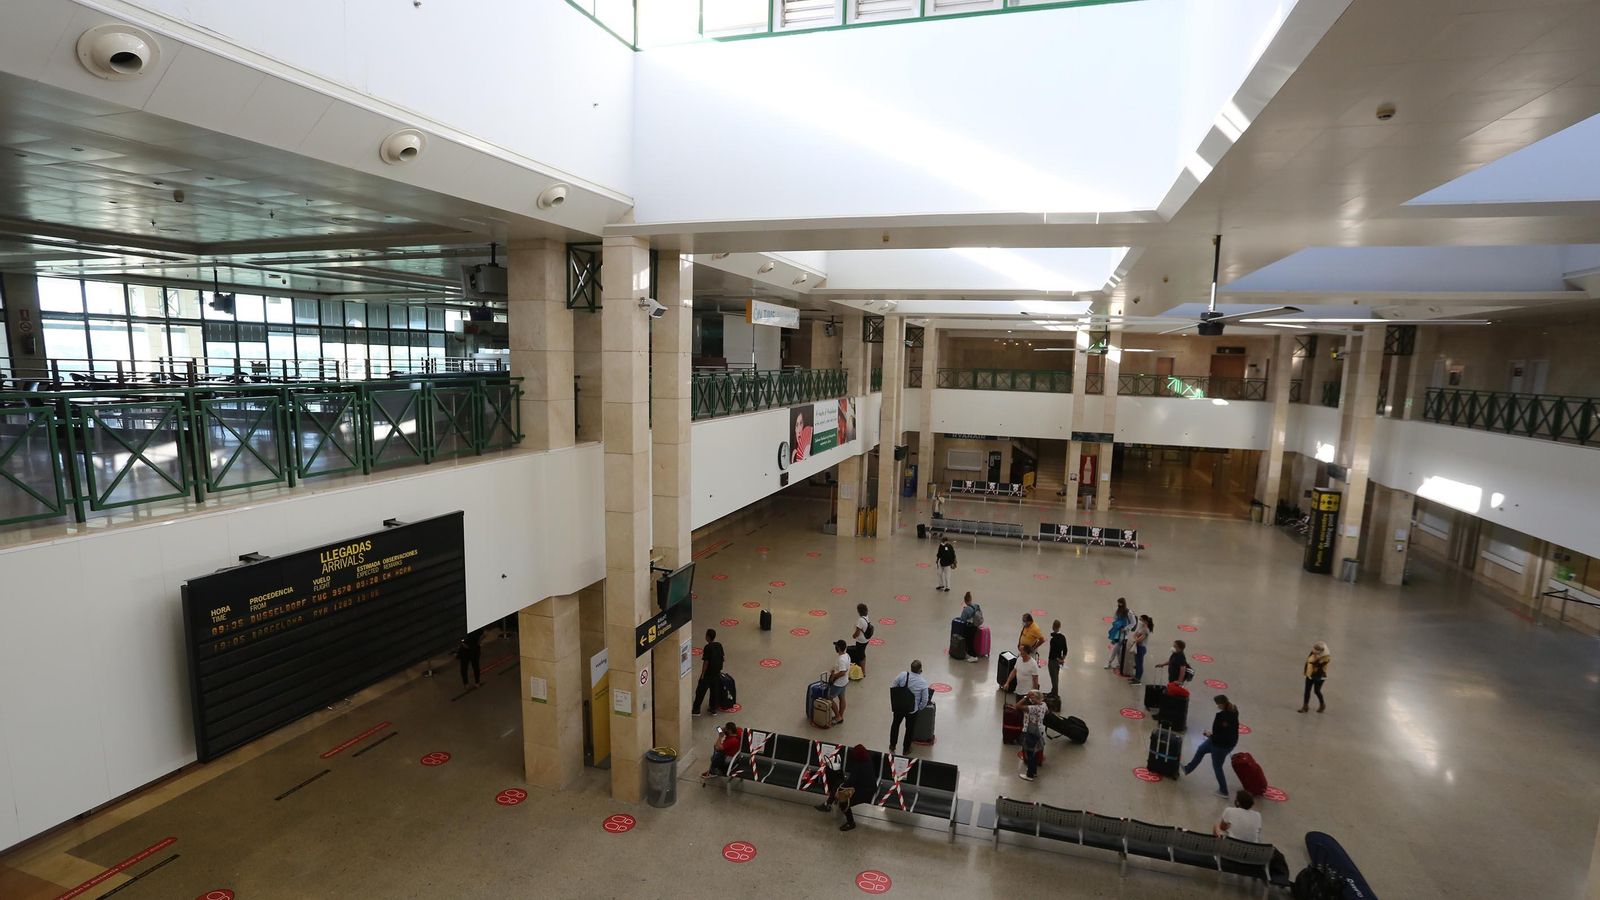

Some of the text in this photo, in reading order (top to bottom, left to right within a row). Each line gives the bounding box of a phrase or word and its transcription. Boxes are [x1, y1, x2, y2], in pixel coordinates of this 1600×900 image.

[320, 540, 372, 564] LLEGADAS
[321, 552, 365, 575] ARRIVALS
[210, 549, 419, 617] HORA PROCEDENCIA VUELO ESTIMADA OBSERVACIONES
[211, 613, 228, 623] TIME
[250, 601, 268, 612] FROM
[313, 581, 331, 592] FLIGHT
[250, 598, 307, 624] DUSSELDORF
